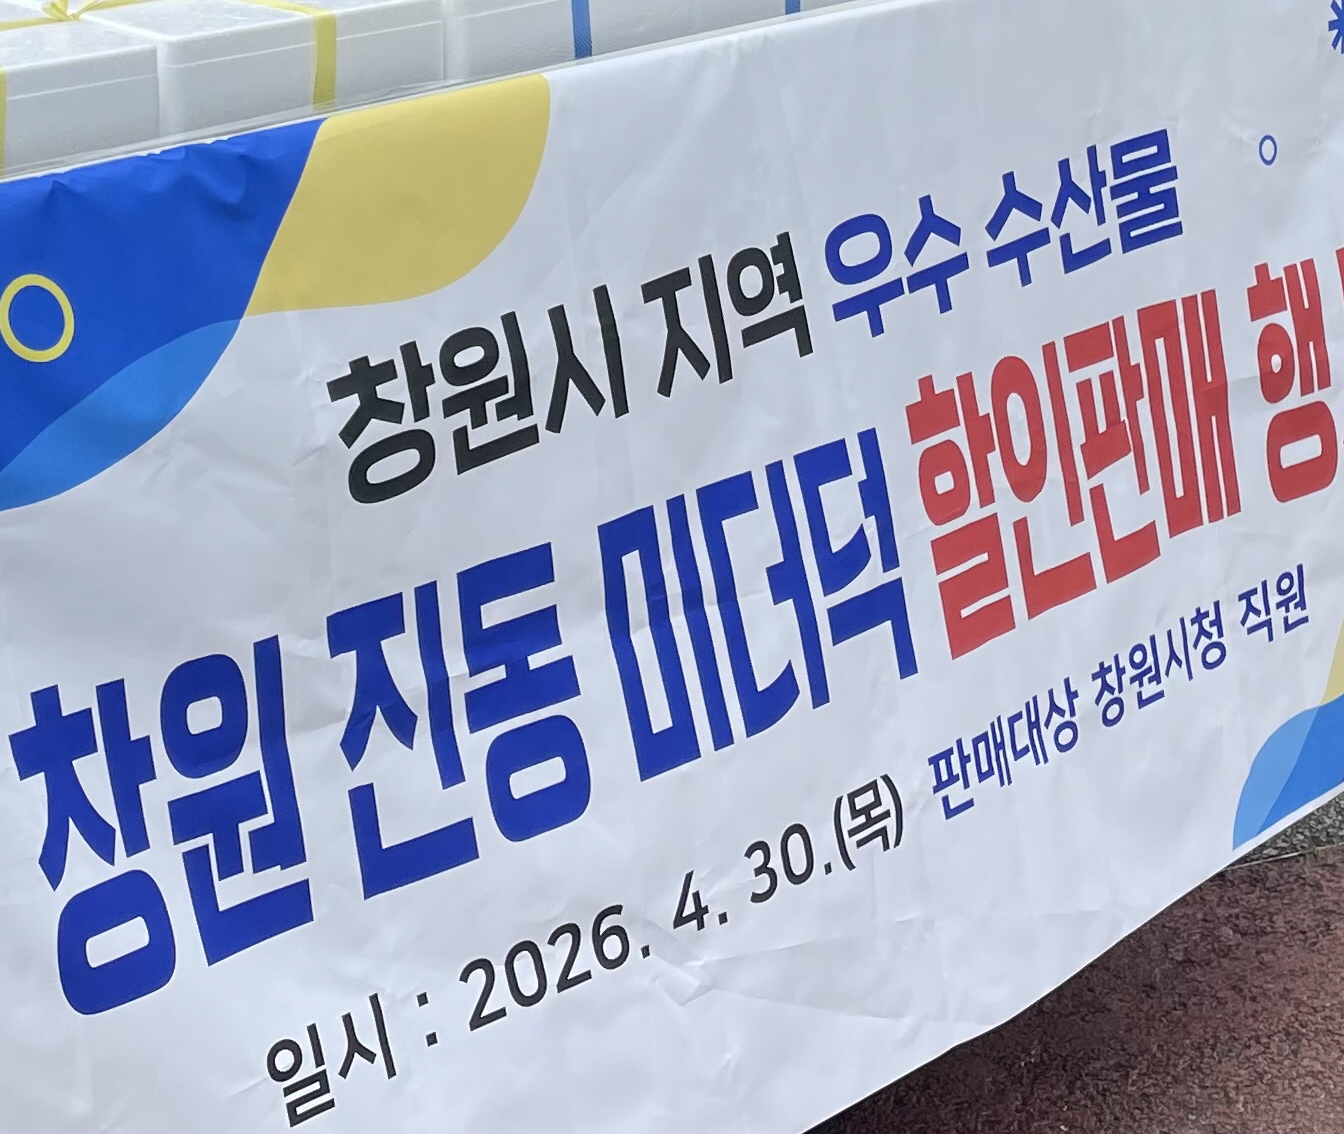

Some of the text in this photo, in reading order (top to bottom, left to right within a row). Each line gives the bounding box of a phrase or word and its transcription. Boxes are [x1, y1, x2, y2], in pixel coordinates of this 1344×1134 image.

[327, 129, 1183, 503] 창원시 지역 우수 수산물
[9, 635, 314, 1014] 창원
[327, 542, 592, 900] 진동
[598, 428, 918, 782] 미더덕
[906, 288, 1242, 659] 할인판매
[266, 992, 397, 1127] 일시
[458, 905, 651, 1031] 2026.
[673, 870, 728, 931] 4.
[744, 773, 904, 904] 30.(목)
[928, 677, 1079, 820] 판매대상
[1091, 600, 1227, 727] 창원시청
[1237, 563, 1309, 642] 직원
